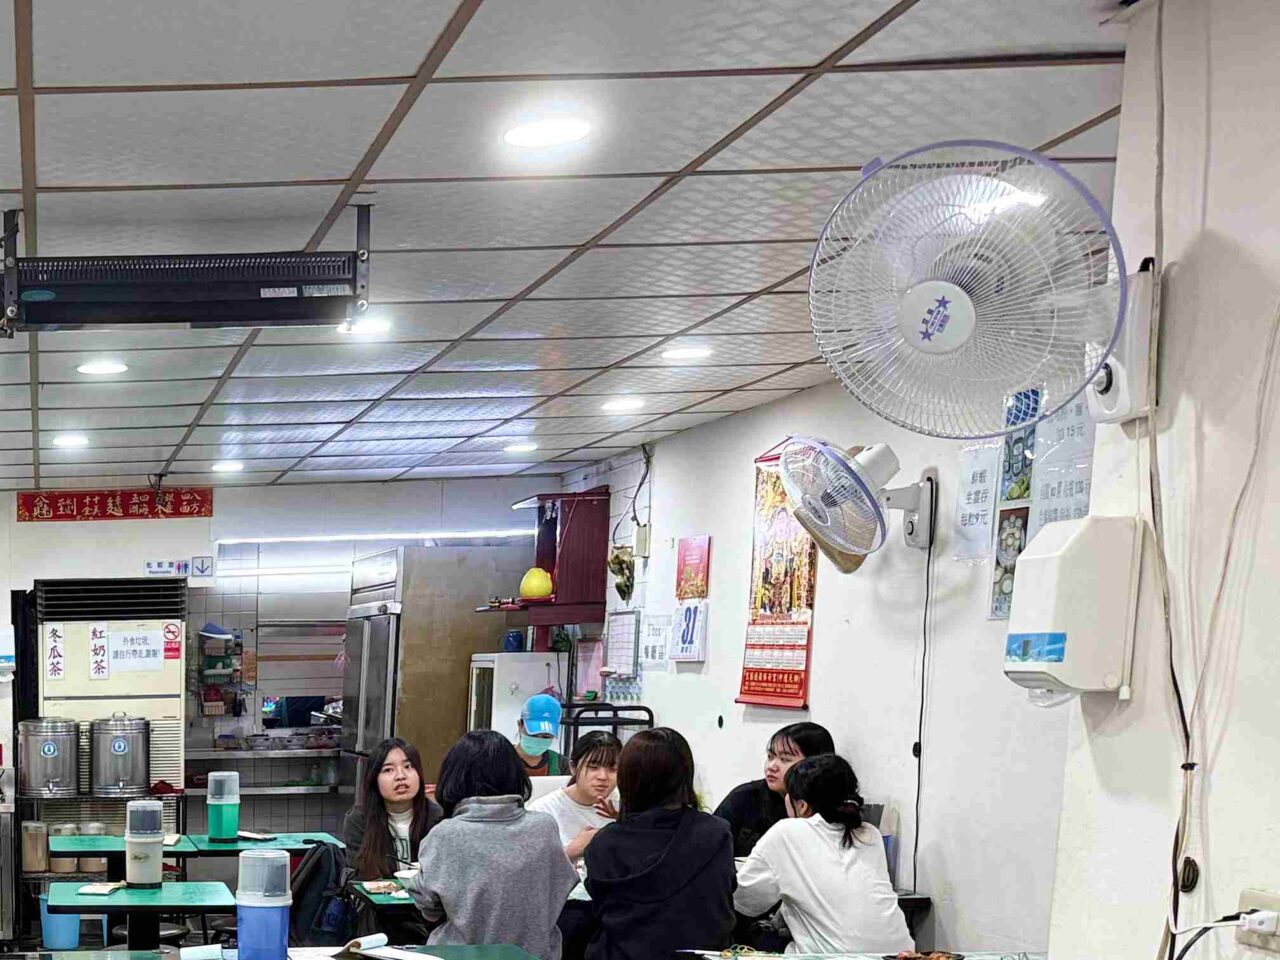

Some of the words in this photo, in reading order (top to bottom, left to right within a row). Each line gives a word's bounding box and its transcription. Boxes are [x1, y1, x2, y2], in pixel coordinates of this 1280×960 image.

[680, 605, 699, 645] 31
[47, 627, 63, 677] 冬瓜茶
[91, 627, 107, 675] 紅奶茶
